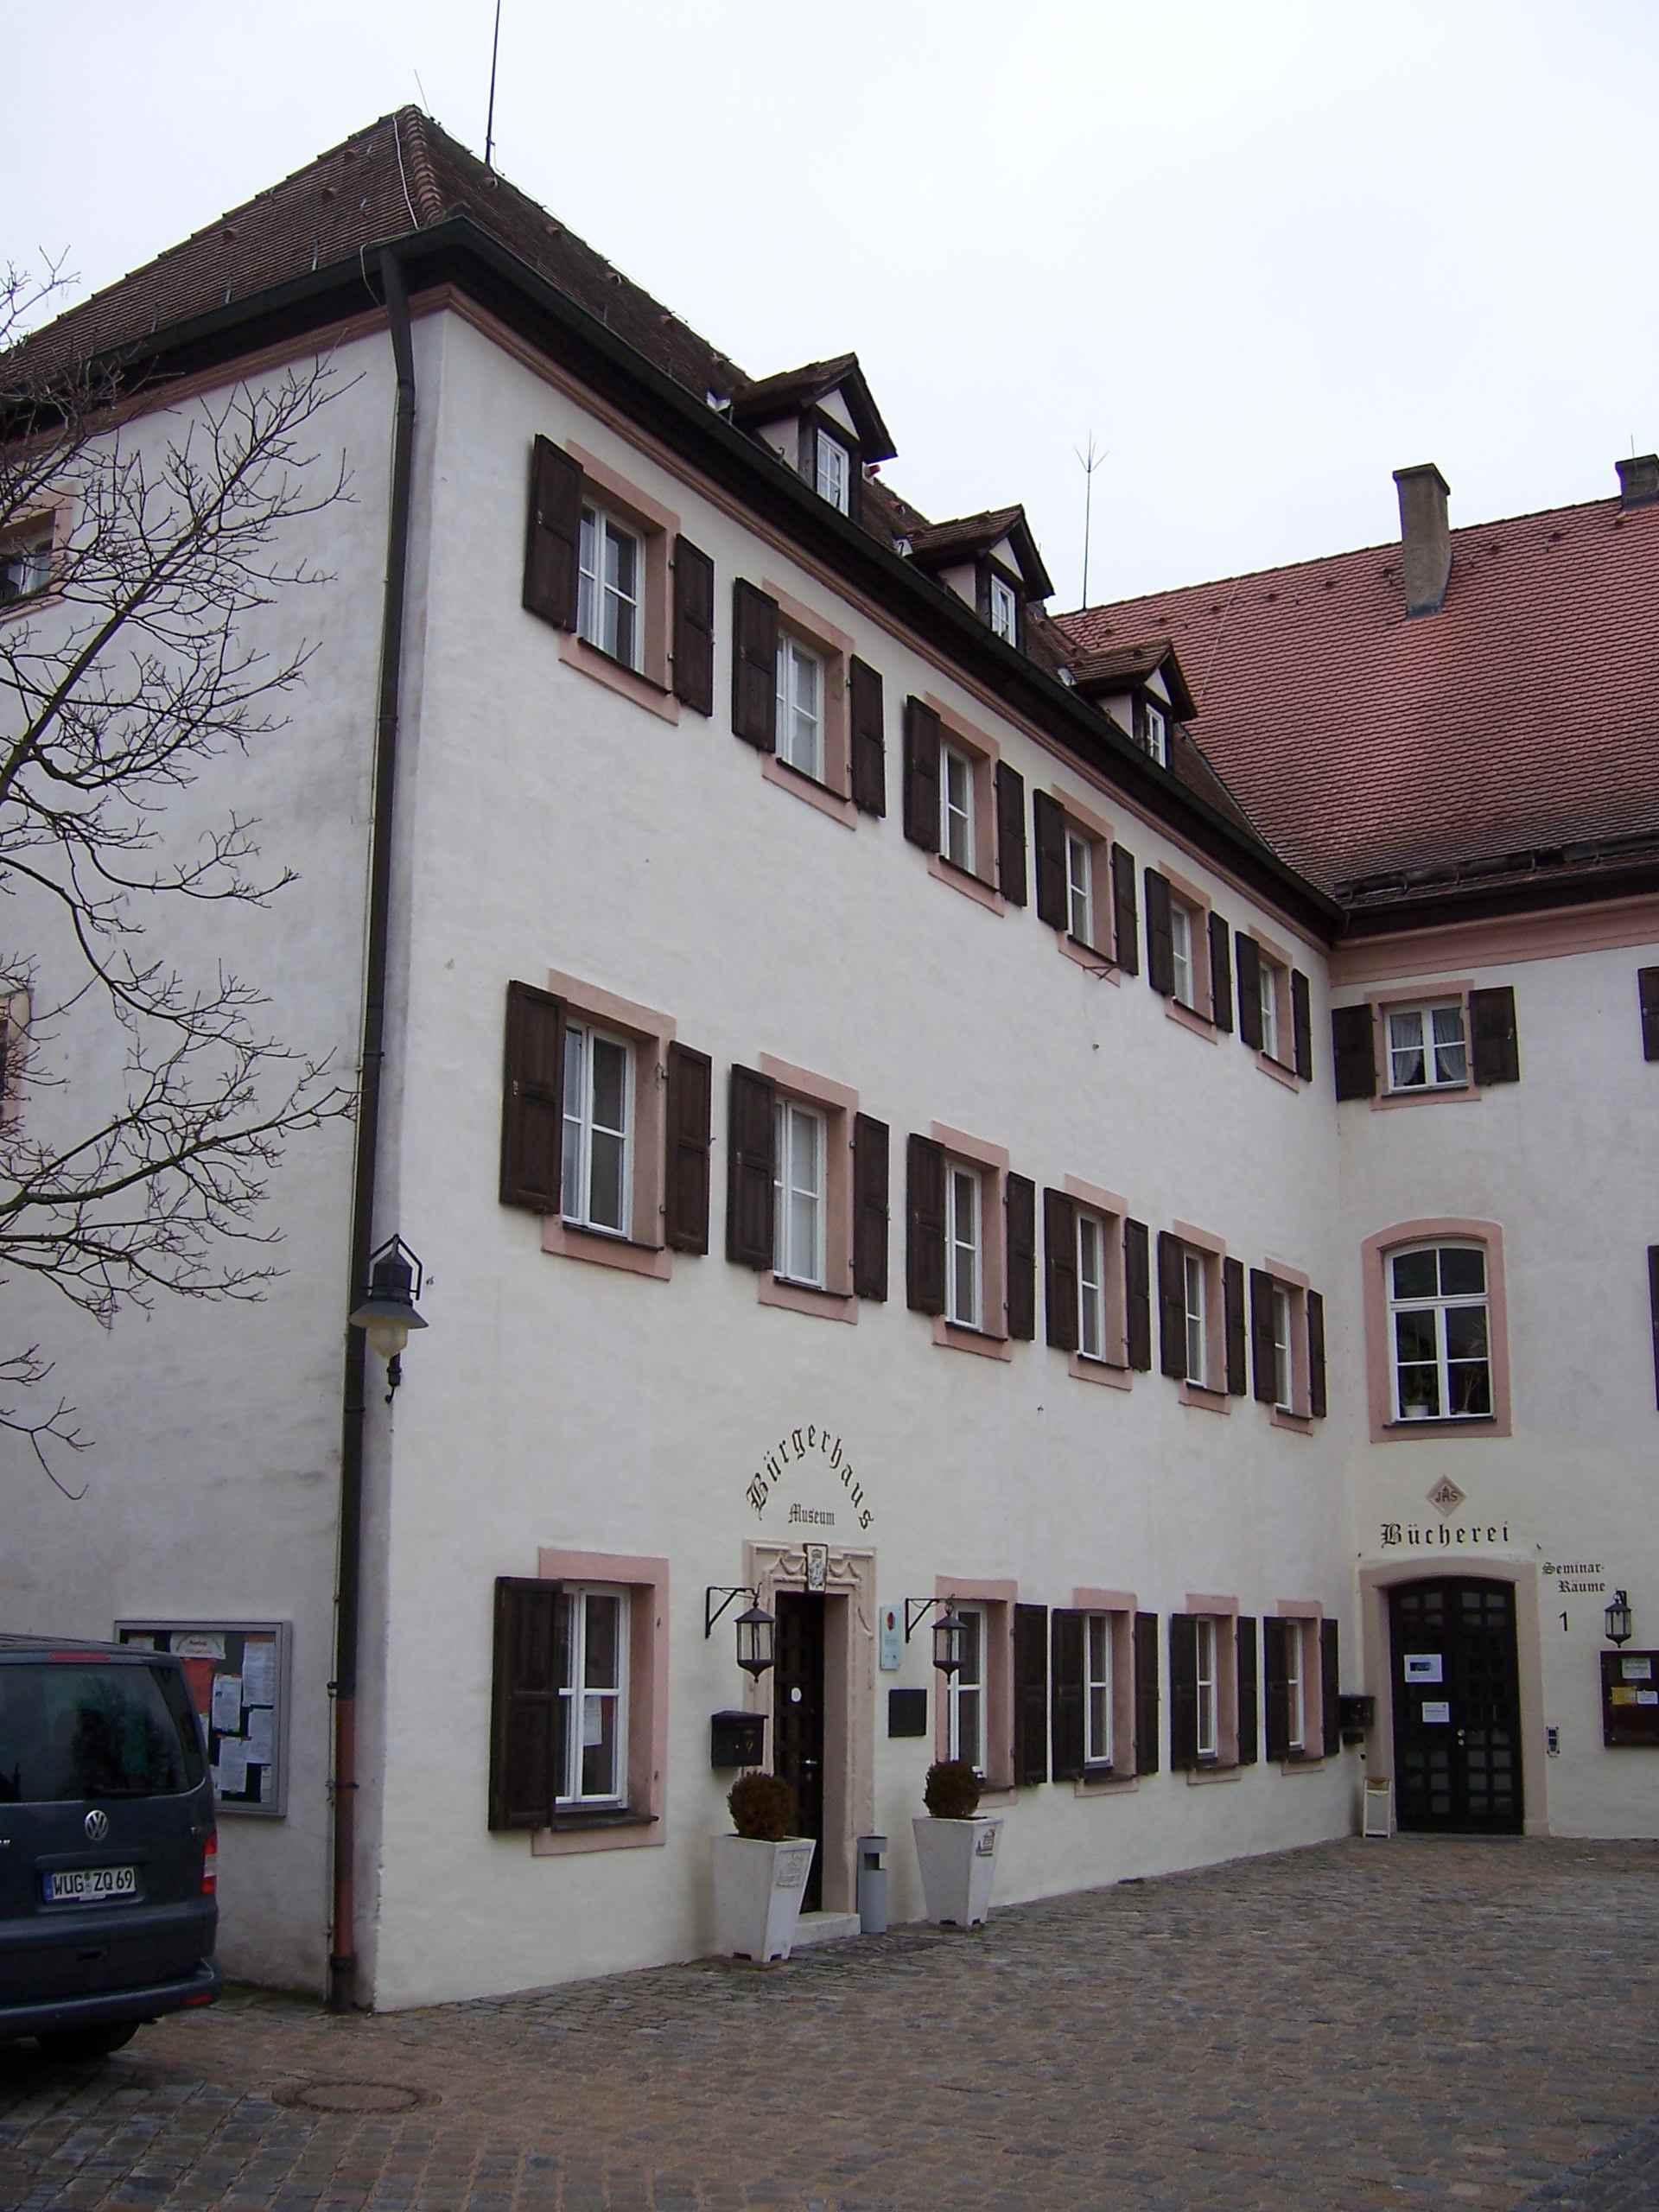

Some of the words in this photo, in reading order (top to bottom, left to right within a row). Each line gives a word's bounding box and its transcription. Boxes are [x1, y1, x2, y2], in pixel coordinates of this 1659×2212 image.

[746, 1424, 874, 1529] Bürgerhaus
[788, 1503, 835, 1526] Museum
[1381, 1521, 1510, 1548] Bücherei
[1559, 1611, 1568, 1632] 1
[54, 1873, 85, 1896] WUG
[93, 1872, 113, 1891] ZQ
[116, 1869, 133, 1890] 69
